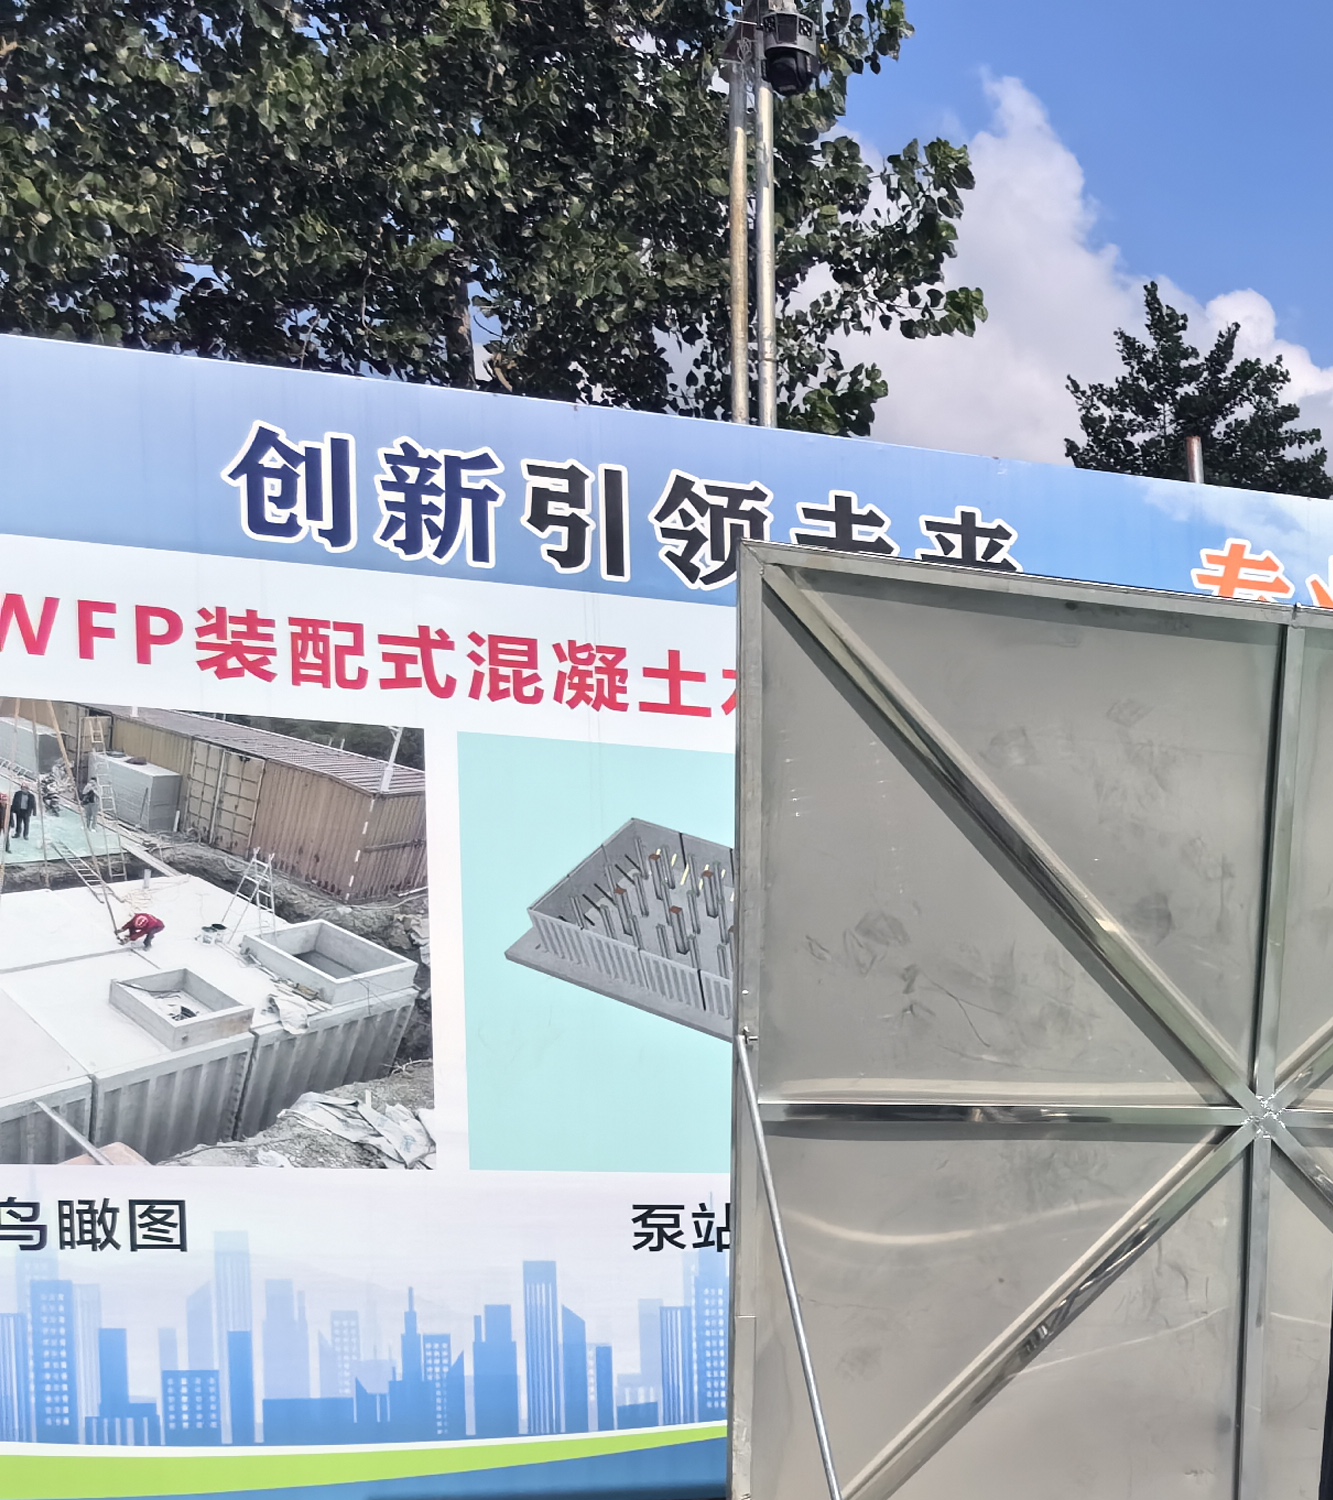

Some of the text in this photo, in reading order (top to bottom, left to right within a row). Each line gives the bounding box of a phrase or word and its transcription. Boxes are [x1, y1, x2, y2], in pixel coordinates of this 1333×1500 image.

[0, 592, 738, 718] WFP装配式混凝土
[0, 1196, 188, 1252] 鸟瞰图
[631, 1203, 731, 1252] 泵站
